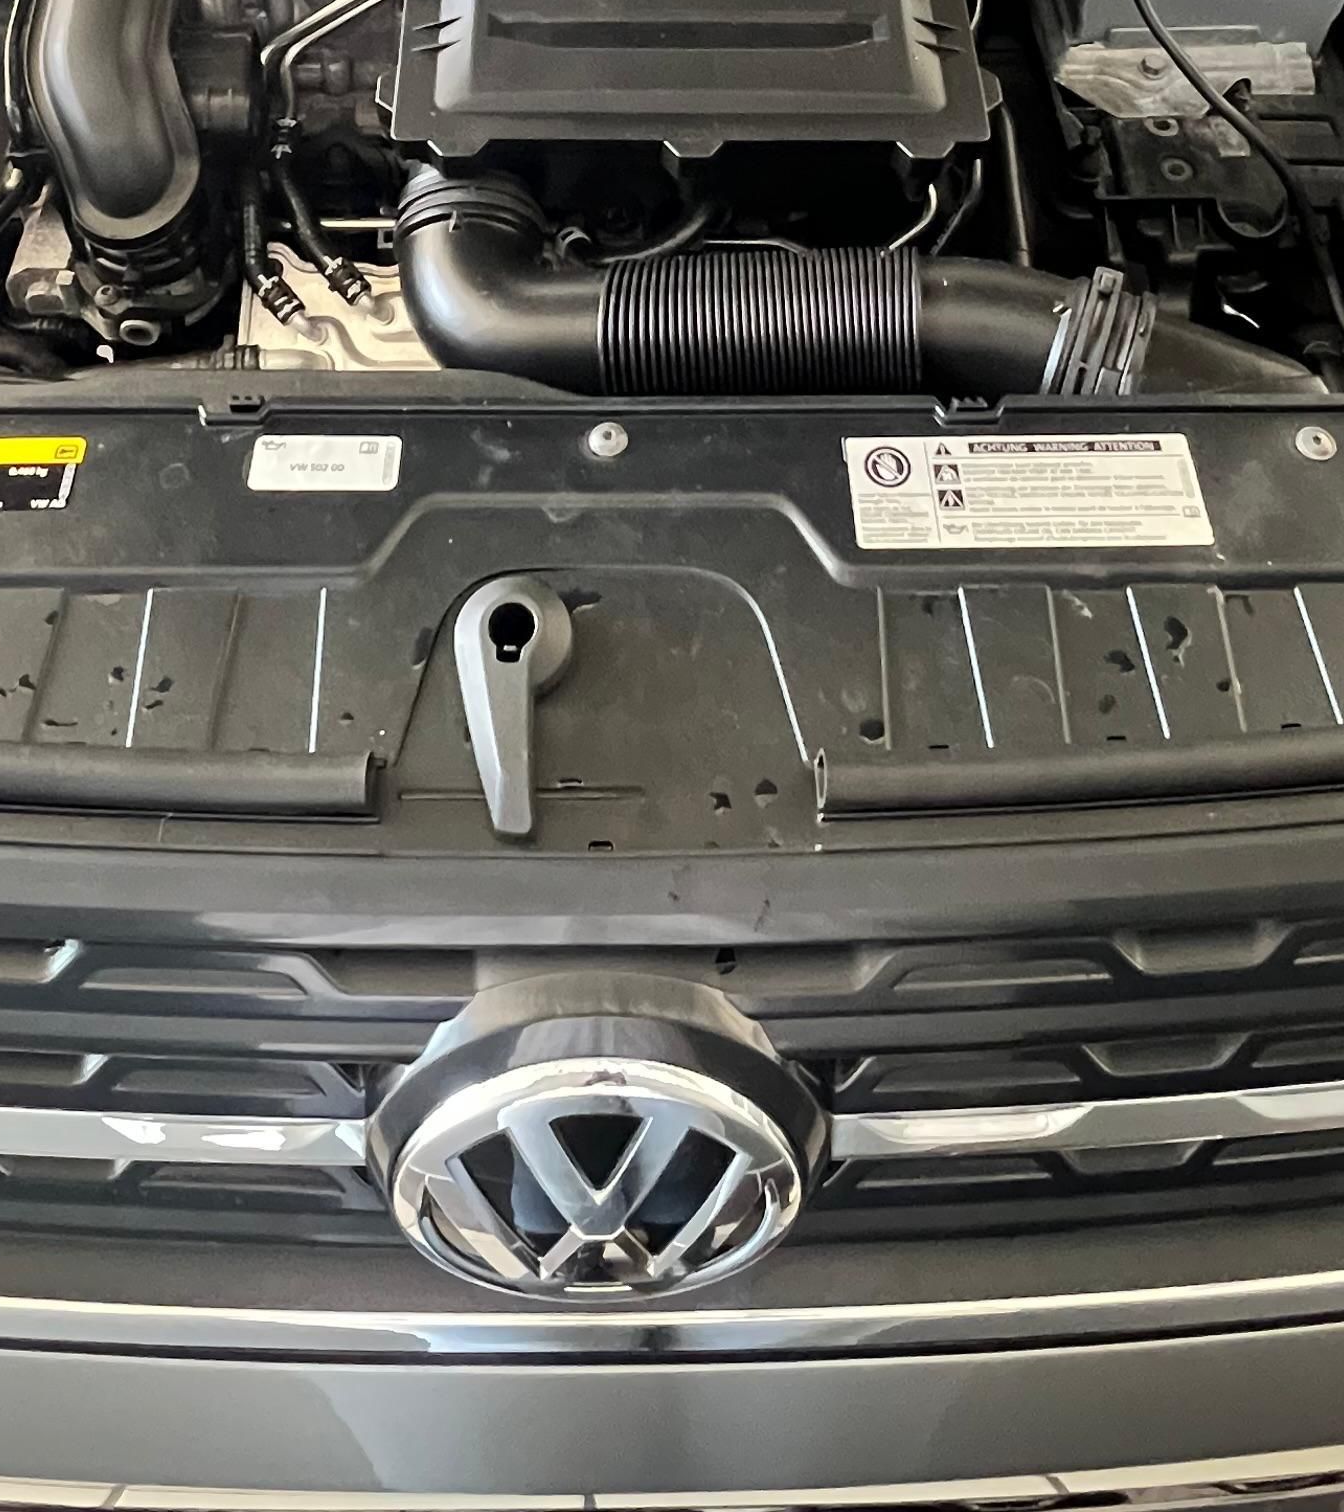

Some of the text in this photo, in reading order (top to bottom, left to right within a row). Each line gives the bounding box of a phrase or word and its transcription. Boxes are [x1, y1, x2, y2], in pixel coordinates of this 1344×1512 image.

[972, 440, 1155, 453] ACHTUNG WARNING ATTENTION
[290, 463, 308, 472] VW
[420, 1088, 768, 1284] VW
